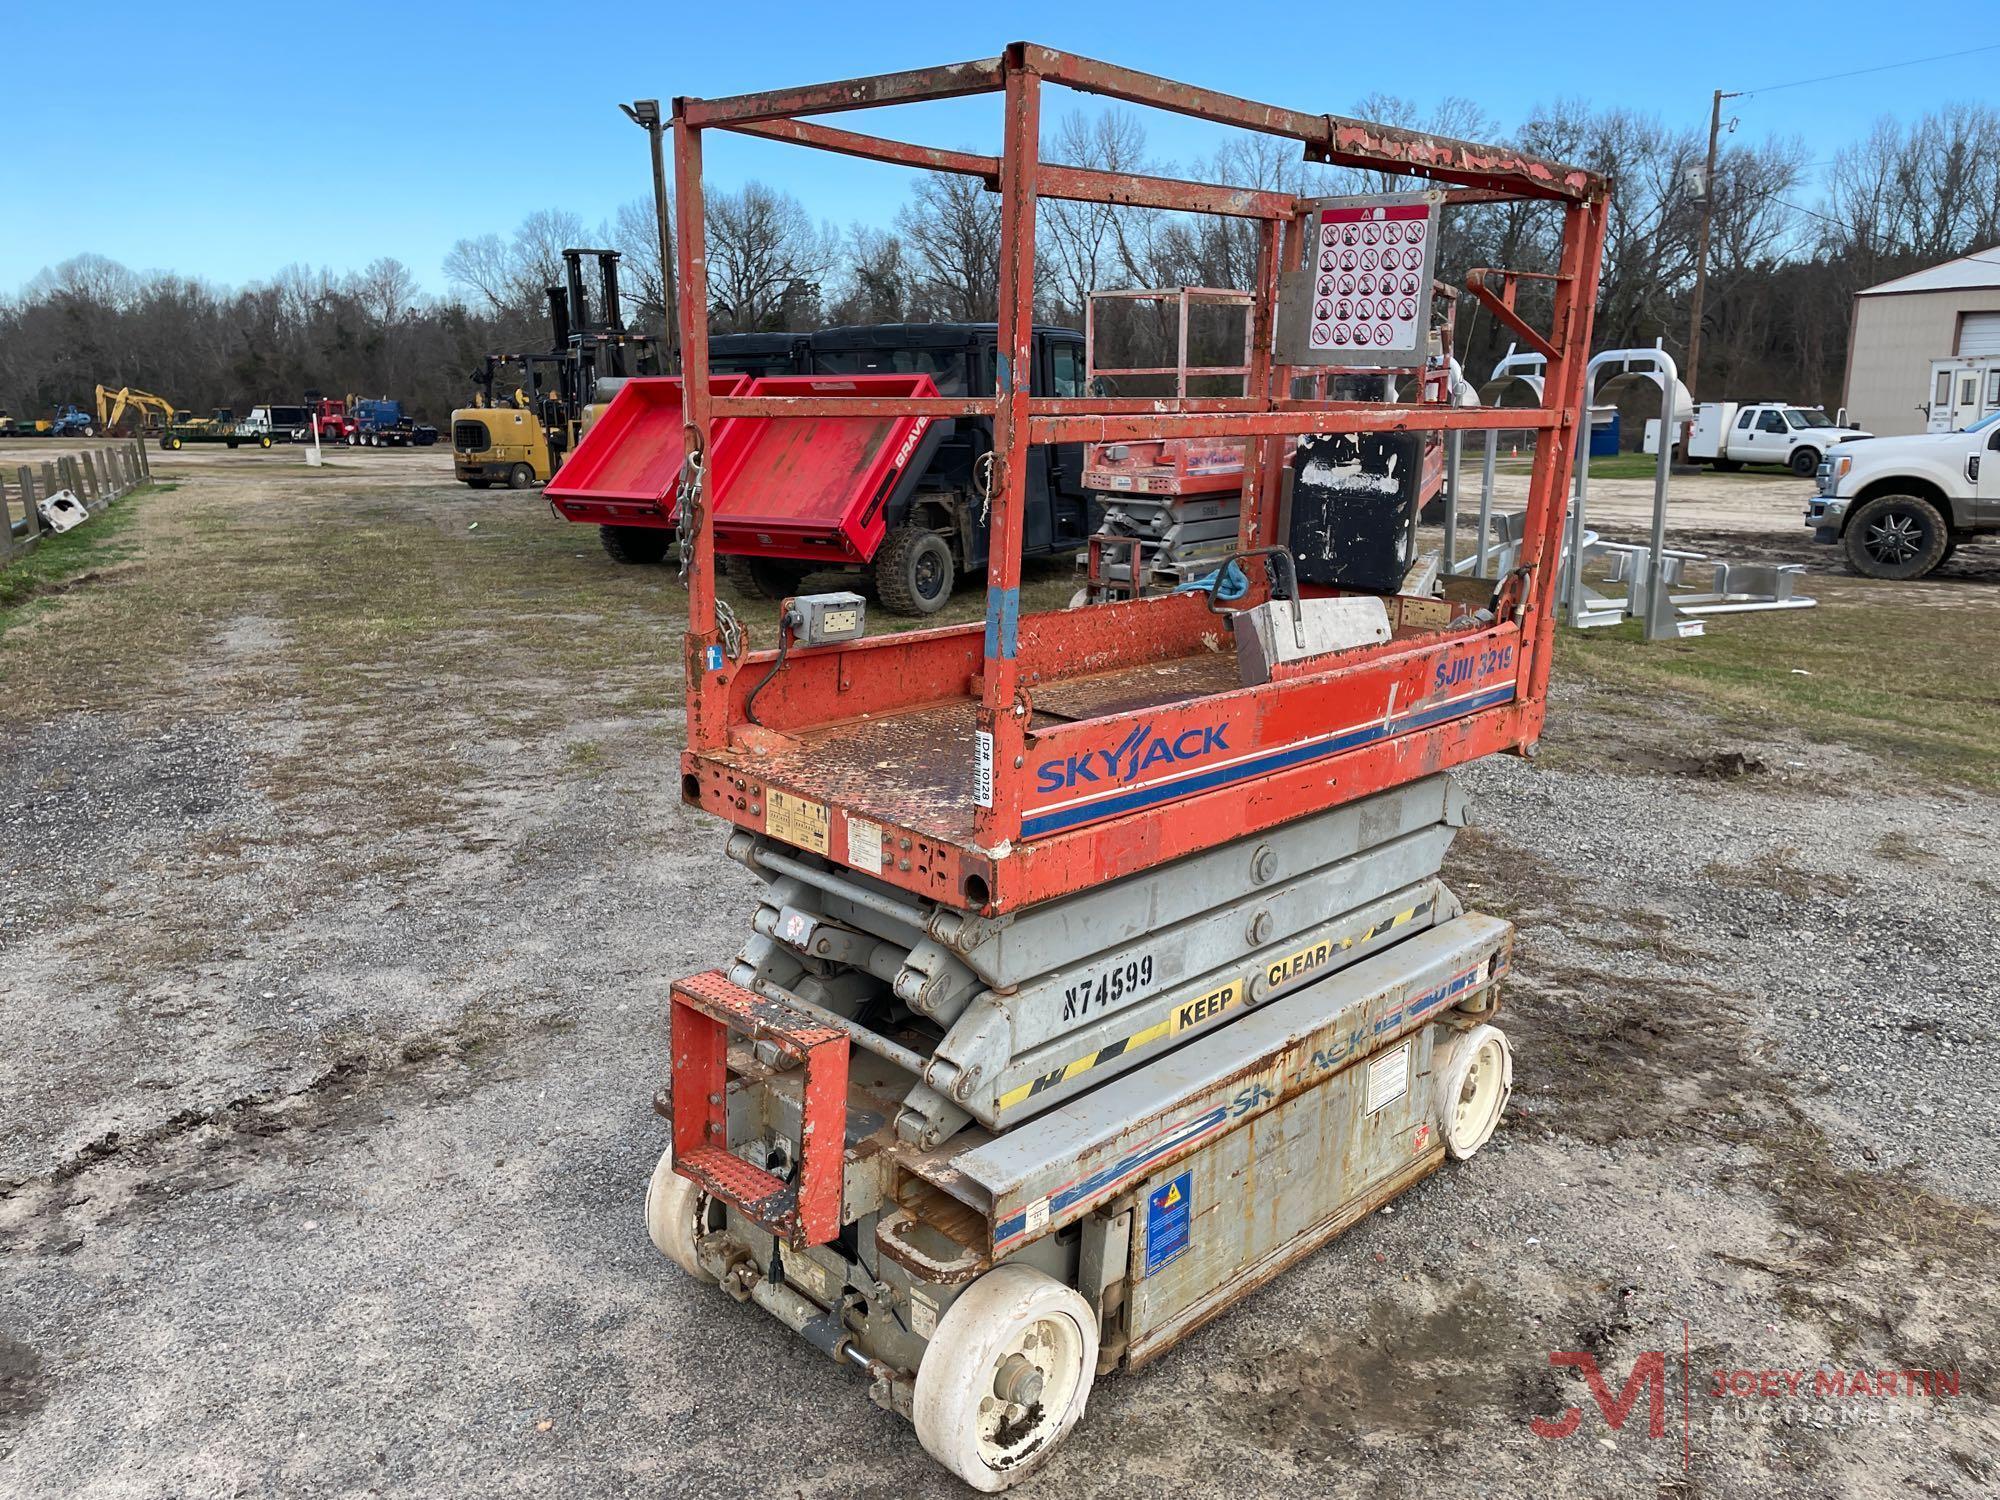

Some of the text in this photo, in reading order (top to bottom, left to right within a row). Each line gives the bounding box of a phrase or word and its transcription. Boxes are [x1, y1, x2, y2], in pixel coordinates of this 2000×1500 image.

[895, 416, 929, 468] GRAVE
[1478, 645, 1513, 677] 3219
[982, 738, 990, 801] ID# 10128
[1037, 722, 1230, 793] SKYJACK
[1063, 955, 1153, 1022] N74599
[1179, 945, 1327, 1030] KEEP CLEAR
